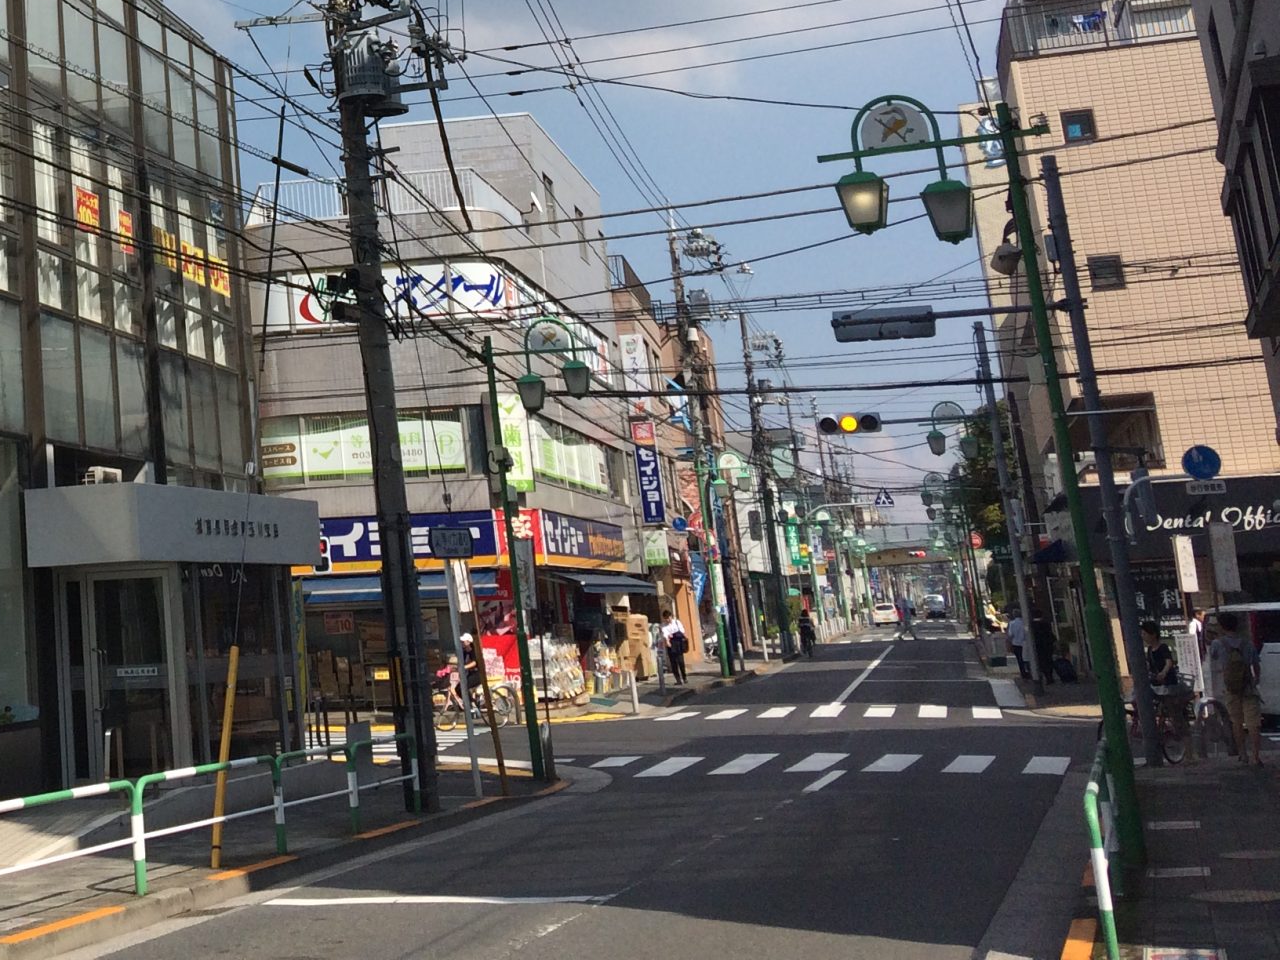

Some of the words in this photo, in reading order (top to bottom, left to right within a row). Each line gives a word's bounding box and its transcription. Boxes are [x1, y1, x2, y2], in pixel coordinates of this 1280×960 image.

[638, 447, 661, 516] セイジョー
[544, 513, 584, 555] セイジョー
